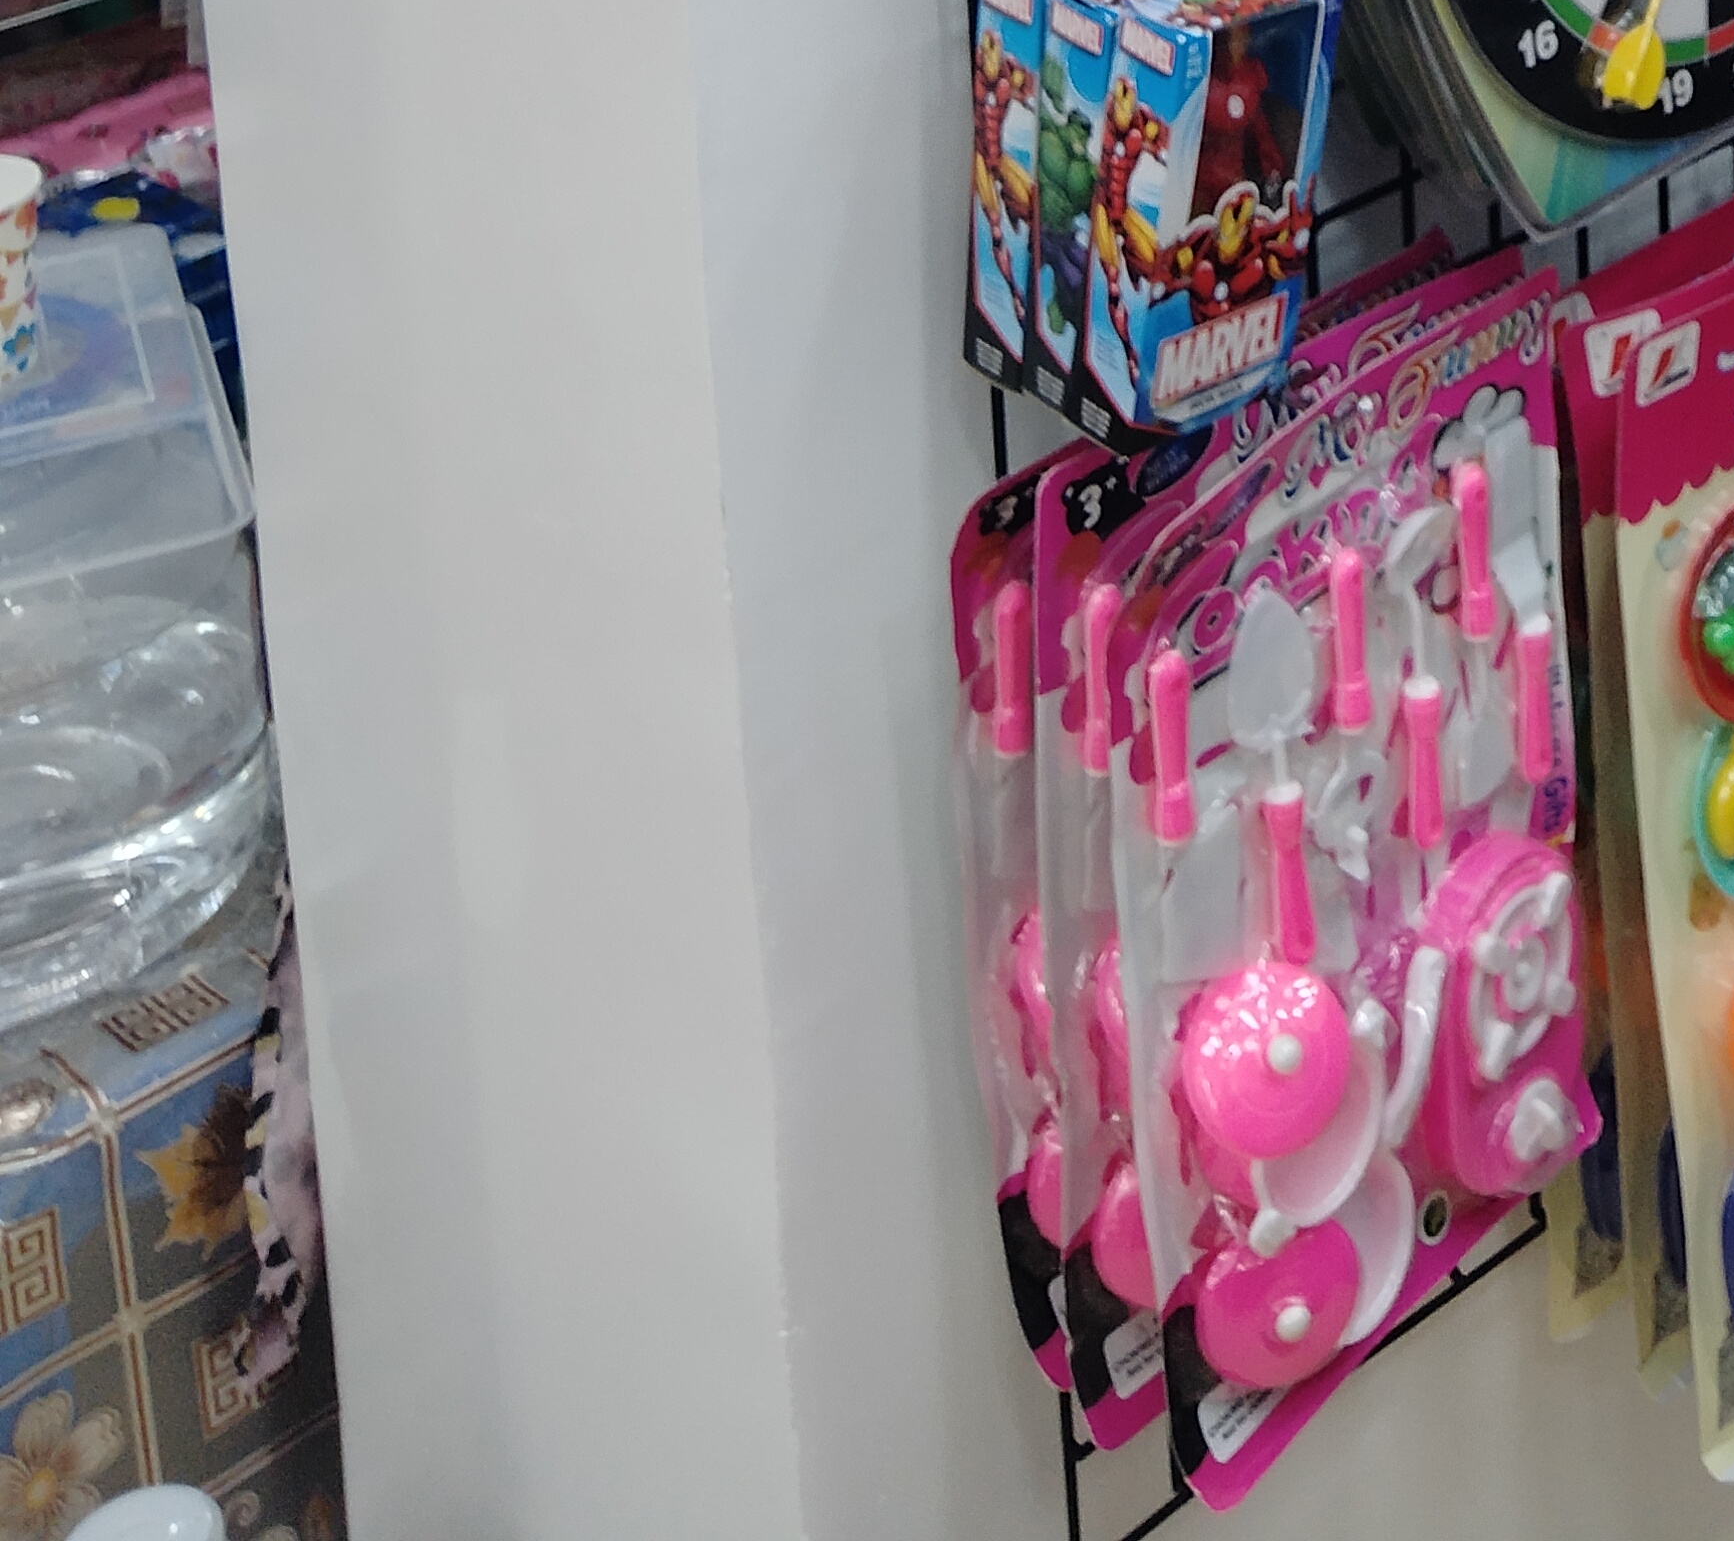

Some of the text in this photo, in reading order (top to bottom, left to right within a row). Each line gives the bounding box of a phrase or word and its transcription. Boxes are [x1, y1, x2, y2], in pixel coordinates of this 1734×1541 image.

[1518, 21, 1559, 69] 16
[1658, 69, 1694, 115] 19
[1154, 297, 1286, 403] MARVEL
